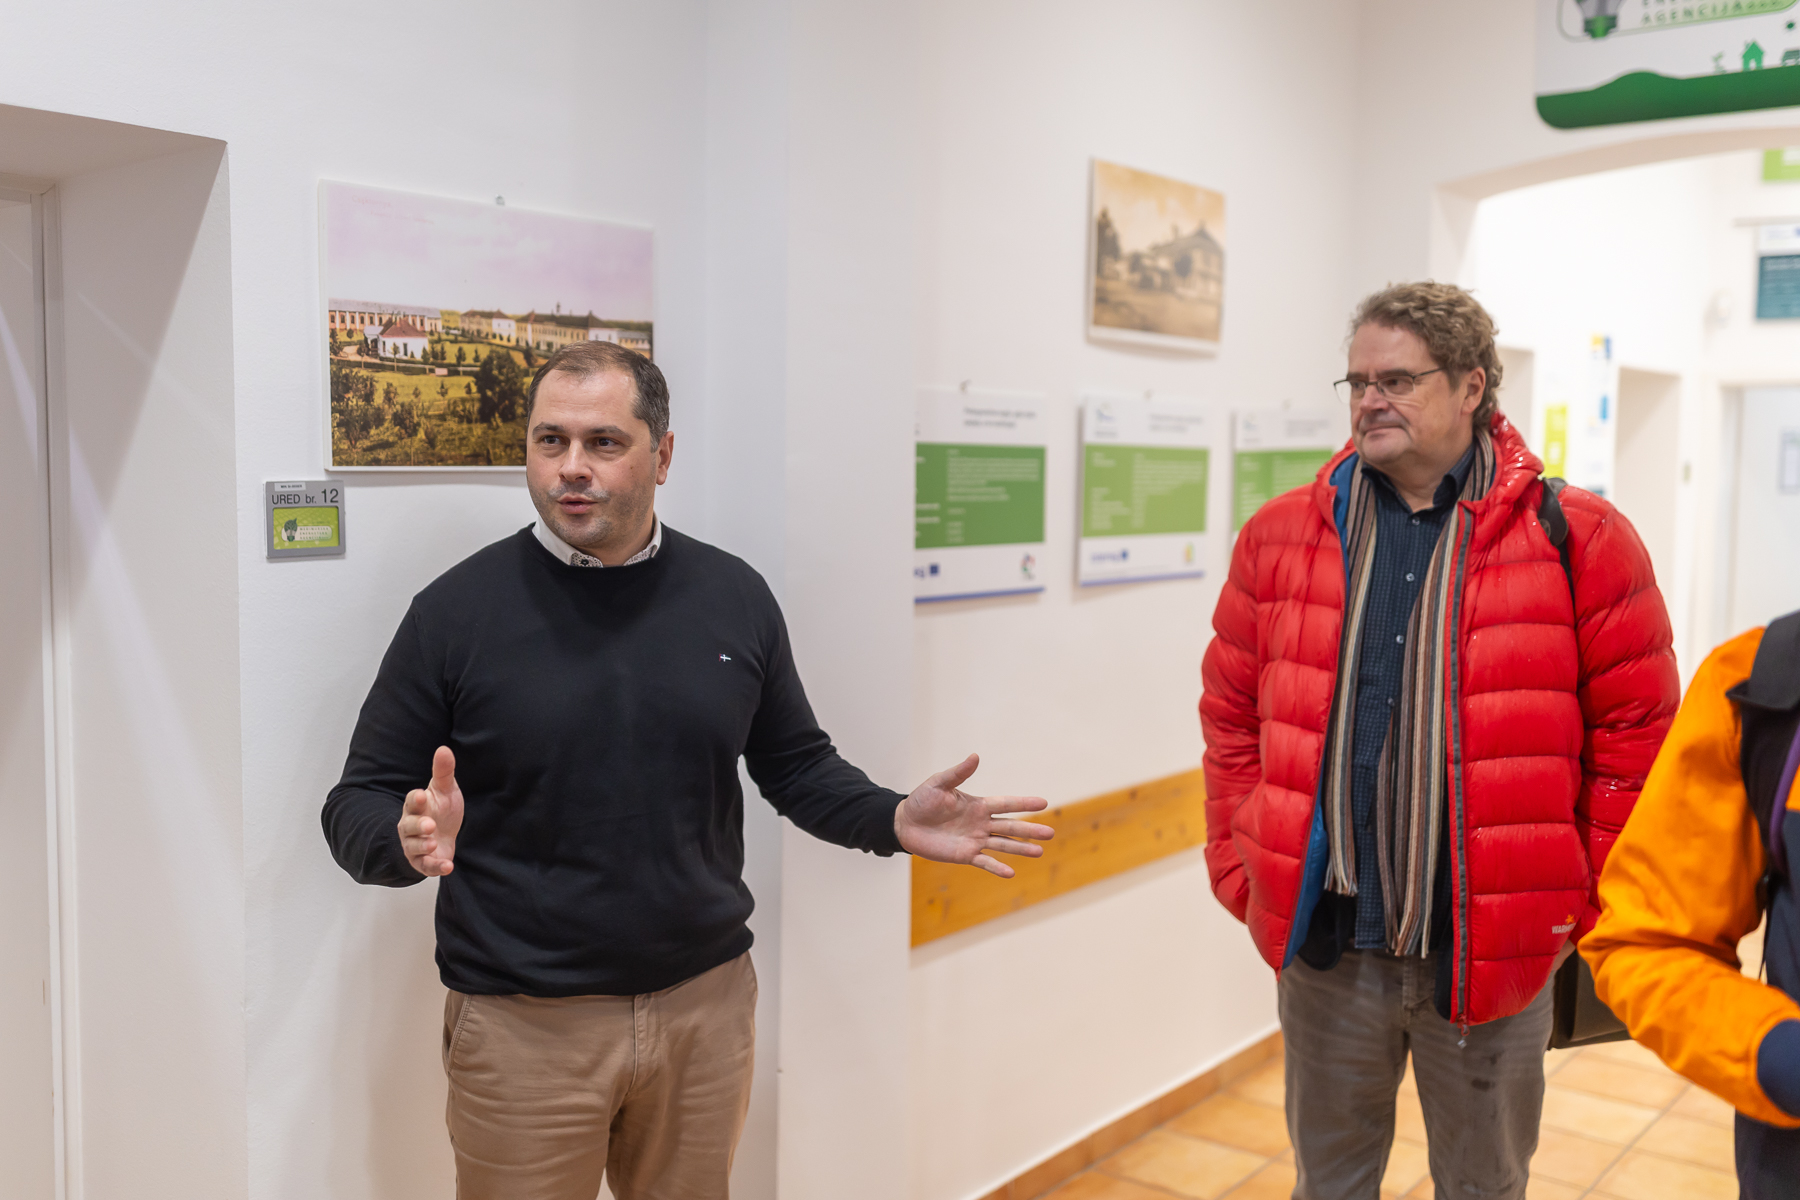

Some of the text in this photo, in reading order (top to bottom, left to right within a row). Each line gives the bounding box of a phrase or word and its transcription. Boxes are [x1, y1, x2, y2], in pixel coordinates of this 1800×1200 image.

[272, 488, 339, 505] URED br. 12
